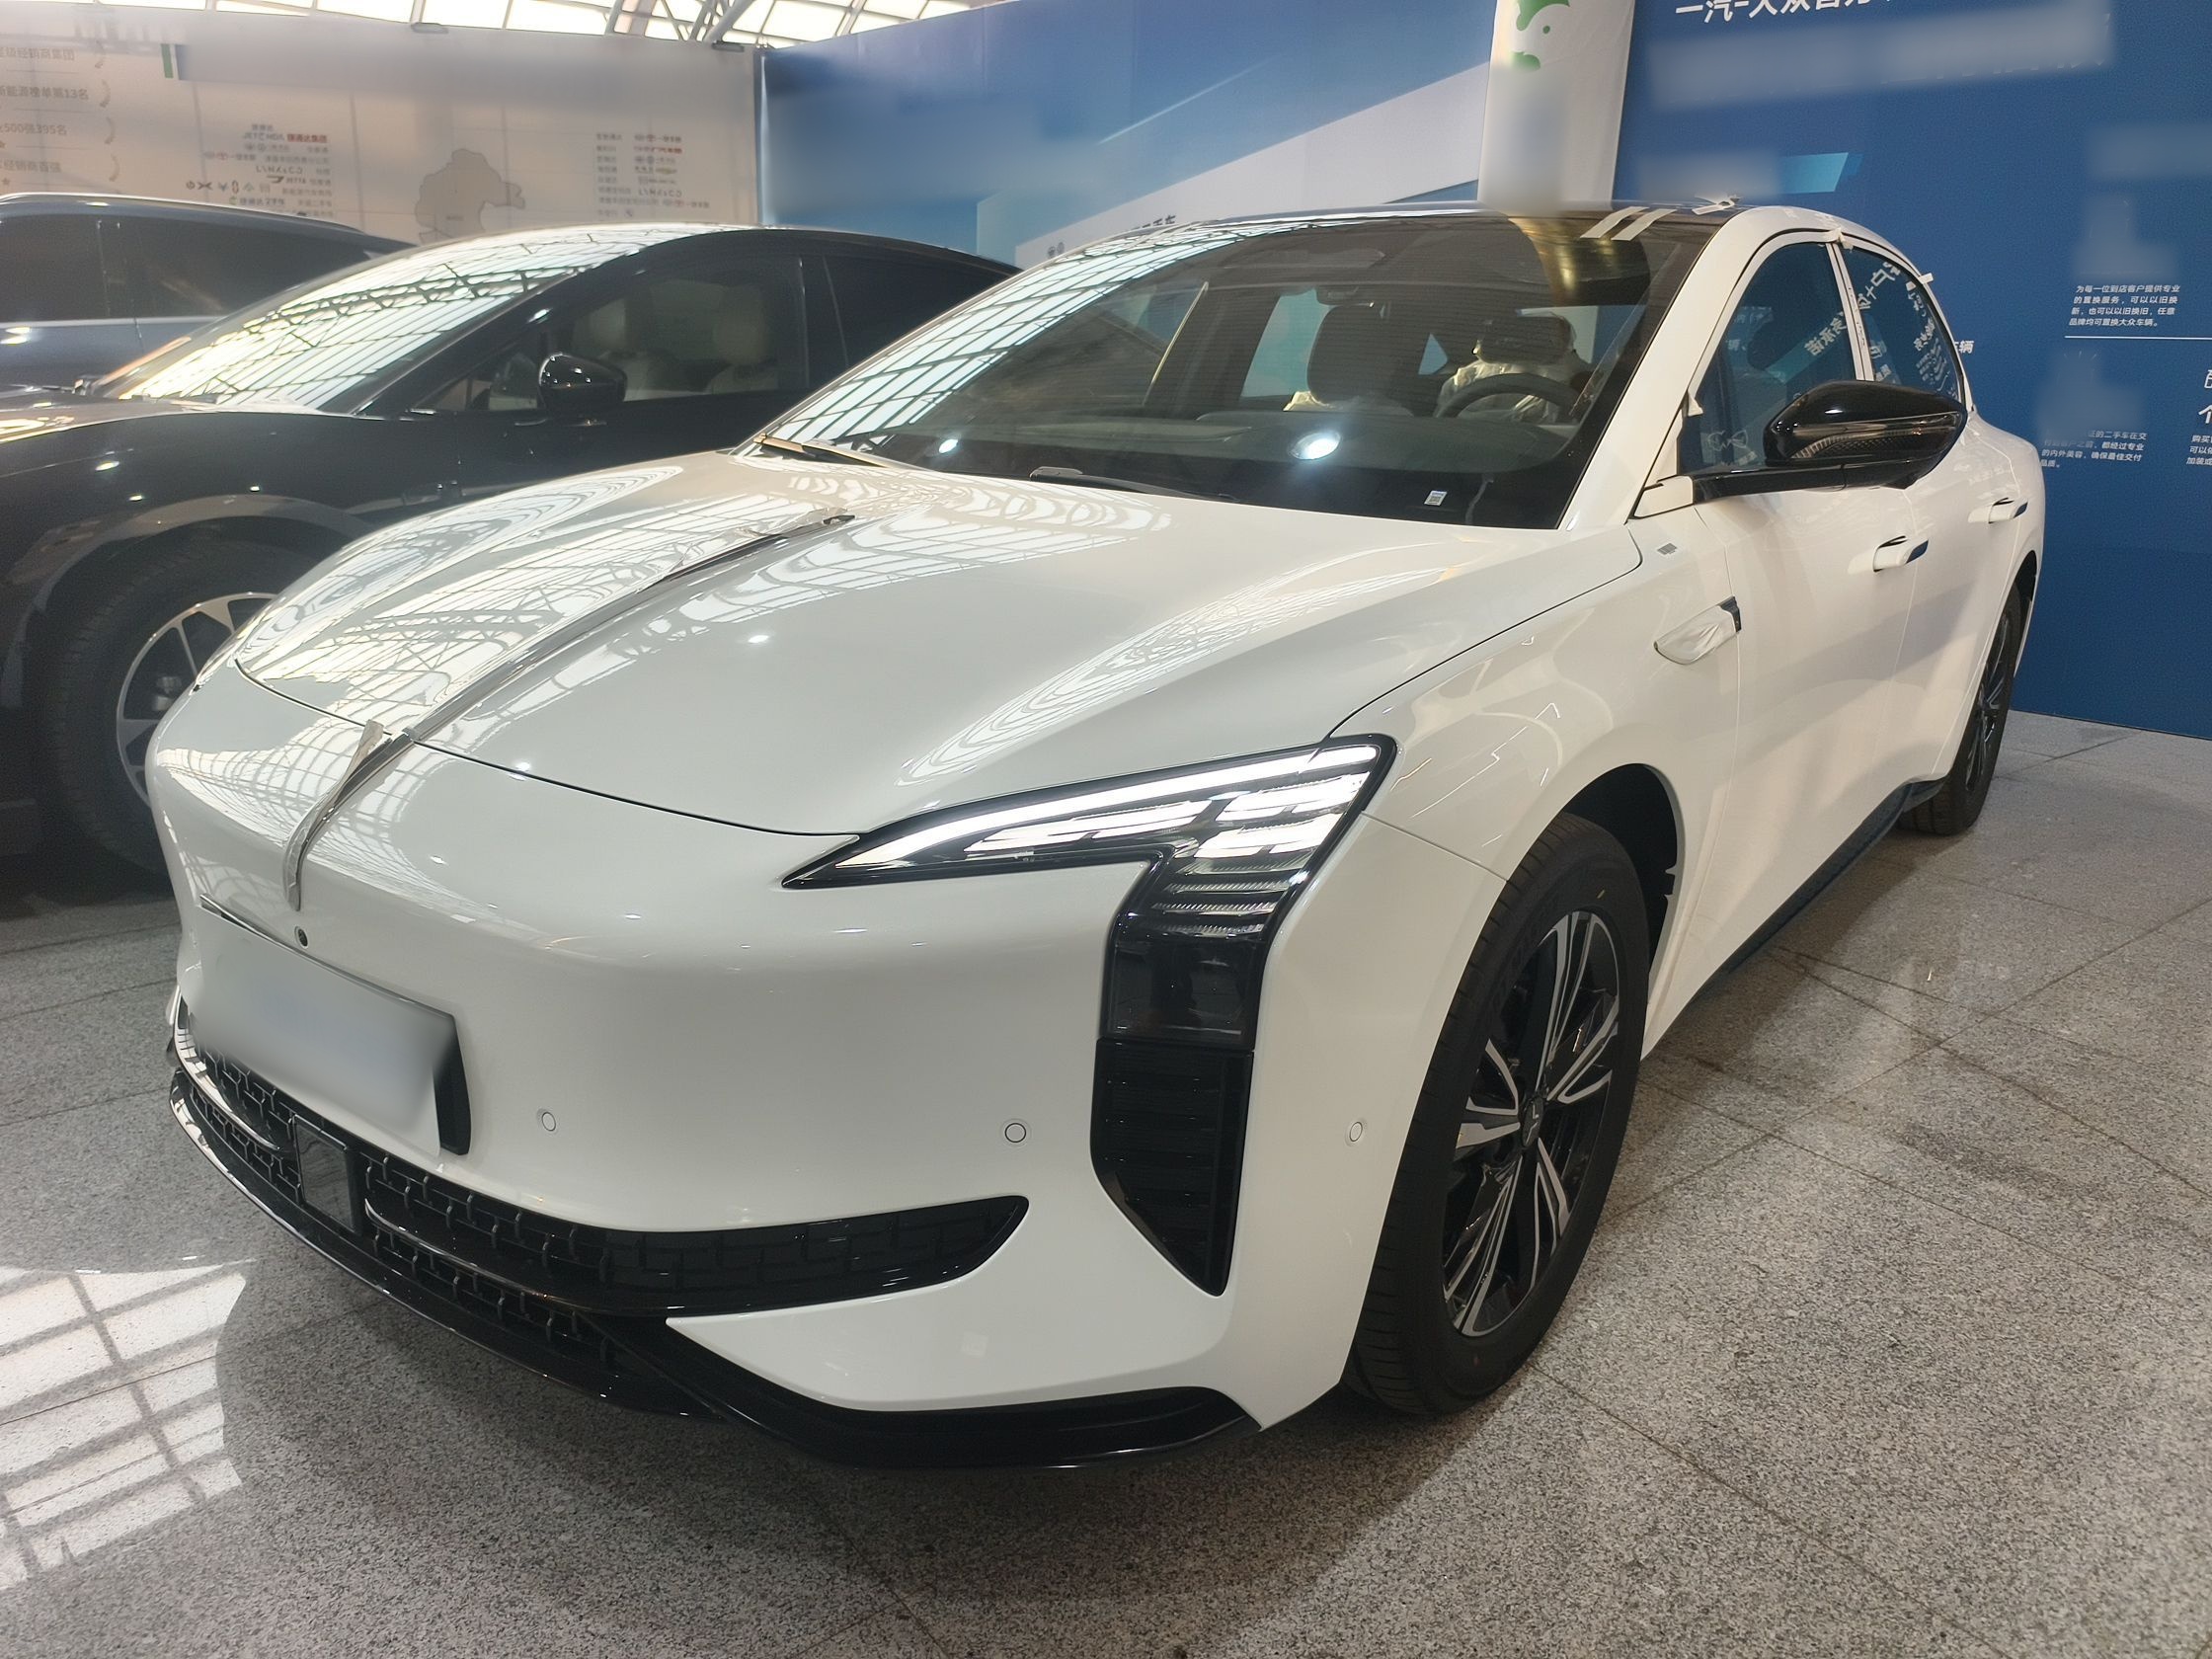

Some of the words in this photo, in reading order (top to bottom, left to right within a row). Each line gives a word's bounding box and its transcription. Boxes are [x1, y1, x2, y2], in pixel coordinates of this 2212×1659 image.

[2076, 284, 2180, 293] 为每一位到店客户提供专业
[2191, 434, 2212, 443] 购买
